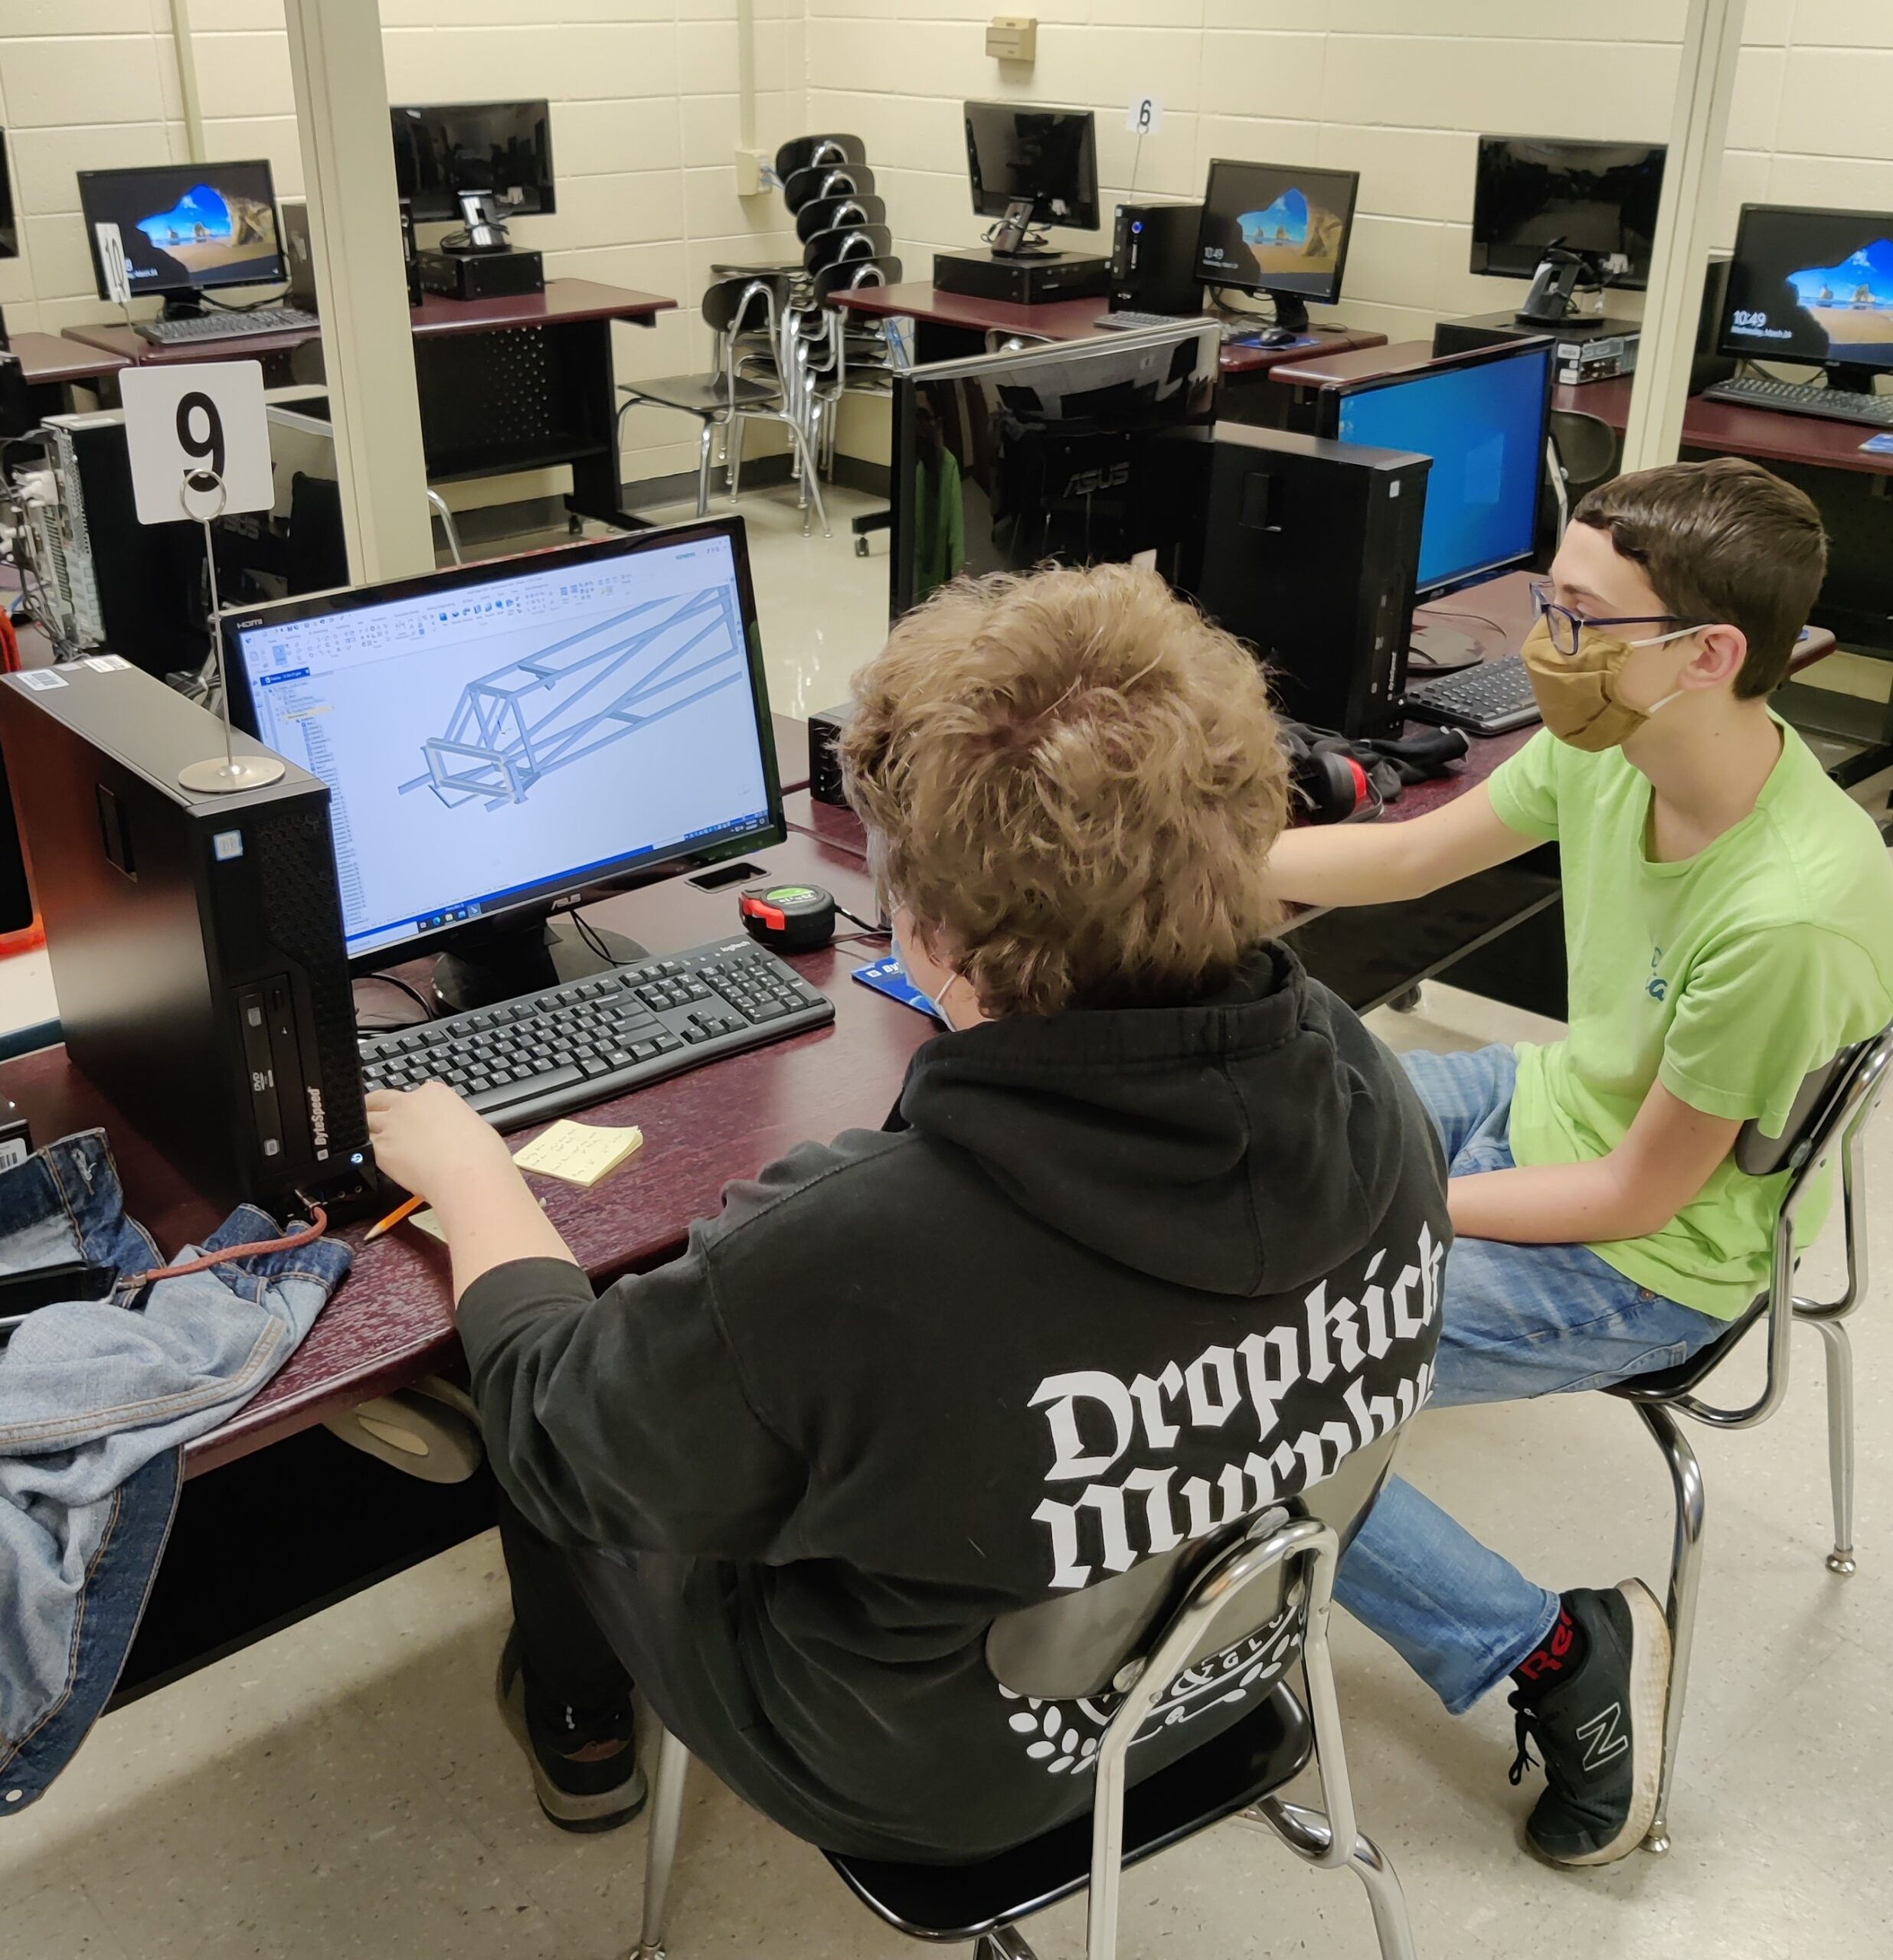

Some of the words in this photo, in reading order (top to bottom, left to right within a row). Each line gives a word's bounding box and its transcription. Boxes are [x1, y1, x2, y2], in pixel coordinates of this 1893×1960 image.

[1139, 99, 1152, 126] 6
[1732, 309, 1767, 328] 10:49
[175, 391, 224, 493] 9
[1062, 461, 1130, 498] ASUS
[237, 618, 263, 629] HDMI
[551, 893, 582, 911] ASUS
[310, 1088, 329, 1145] ByteSpeed
[1028, 1220, 1444, 1481] Dropkick
